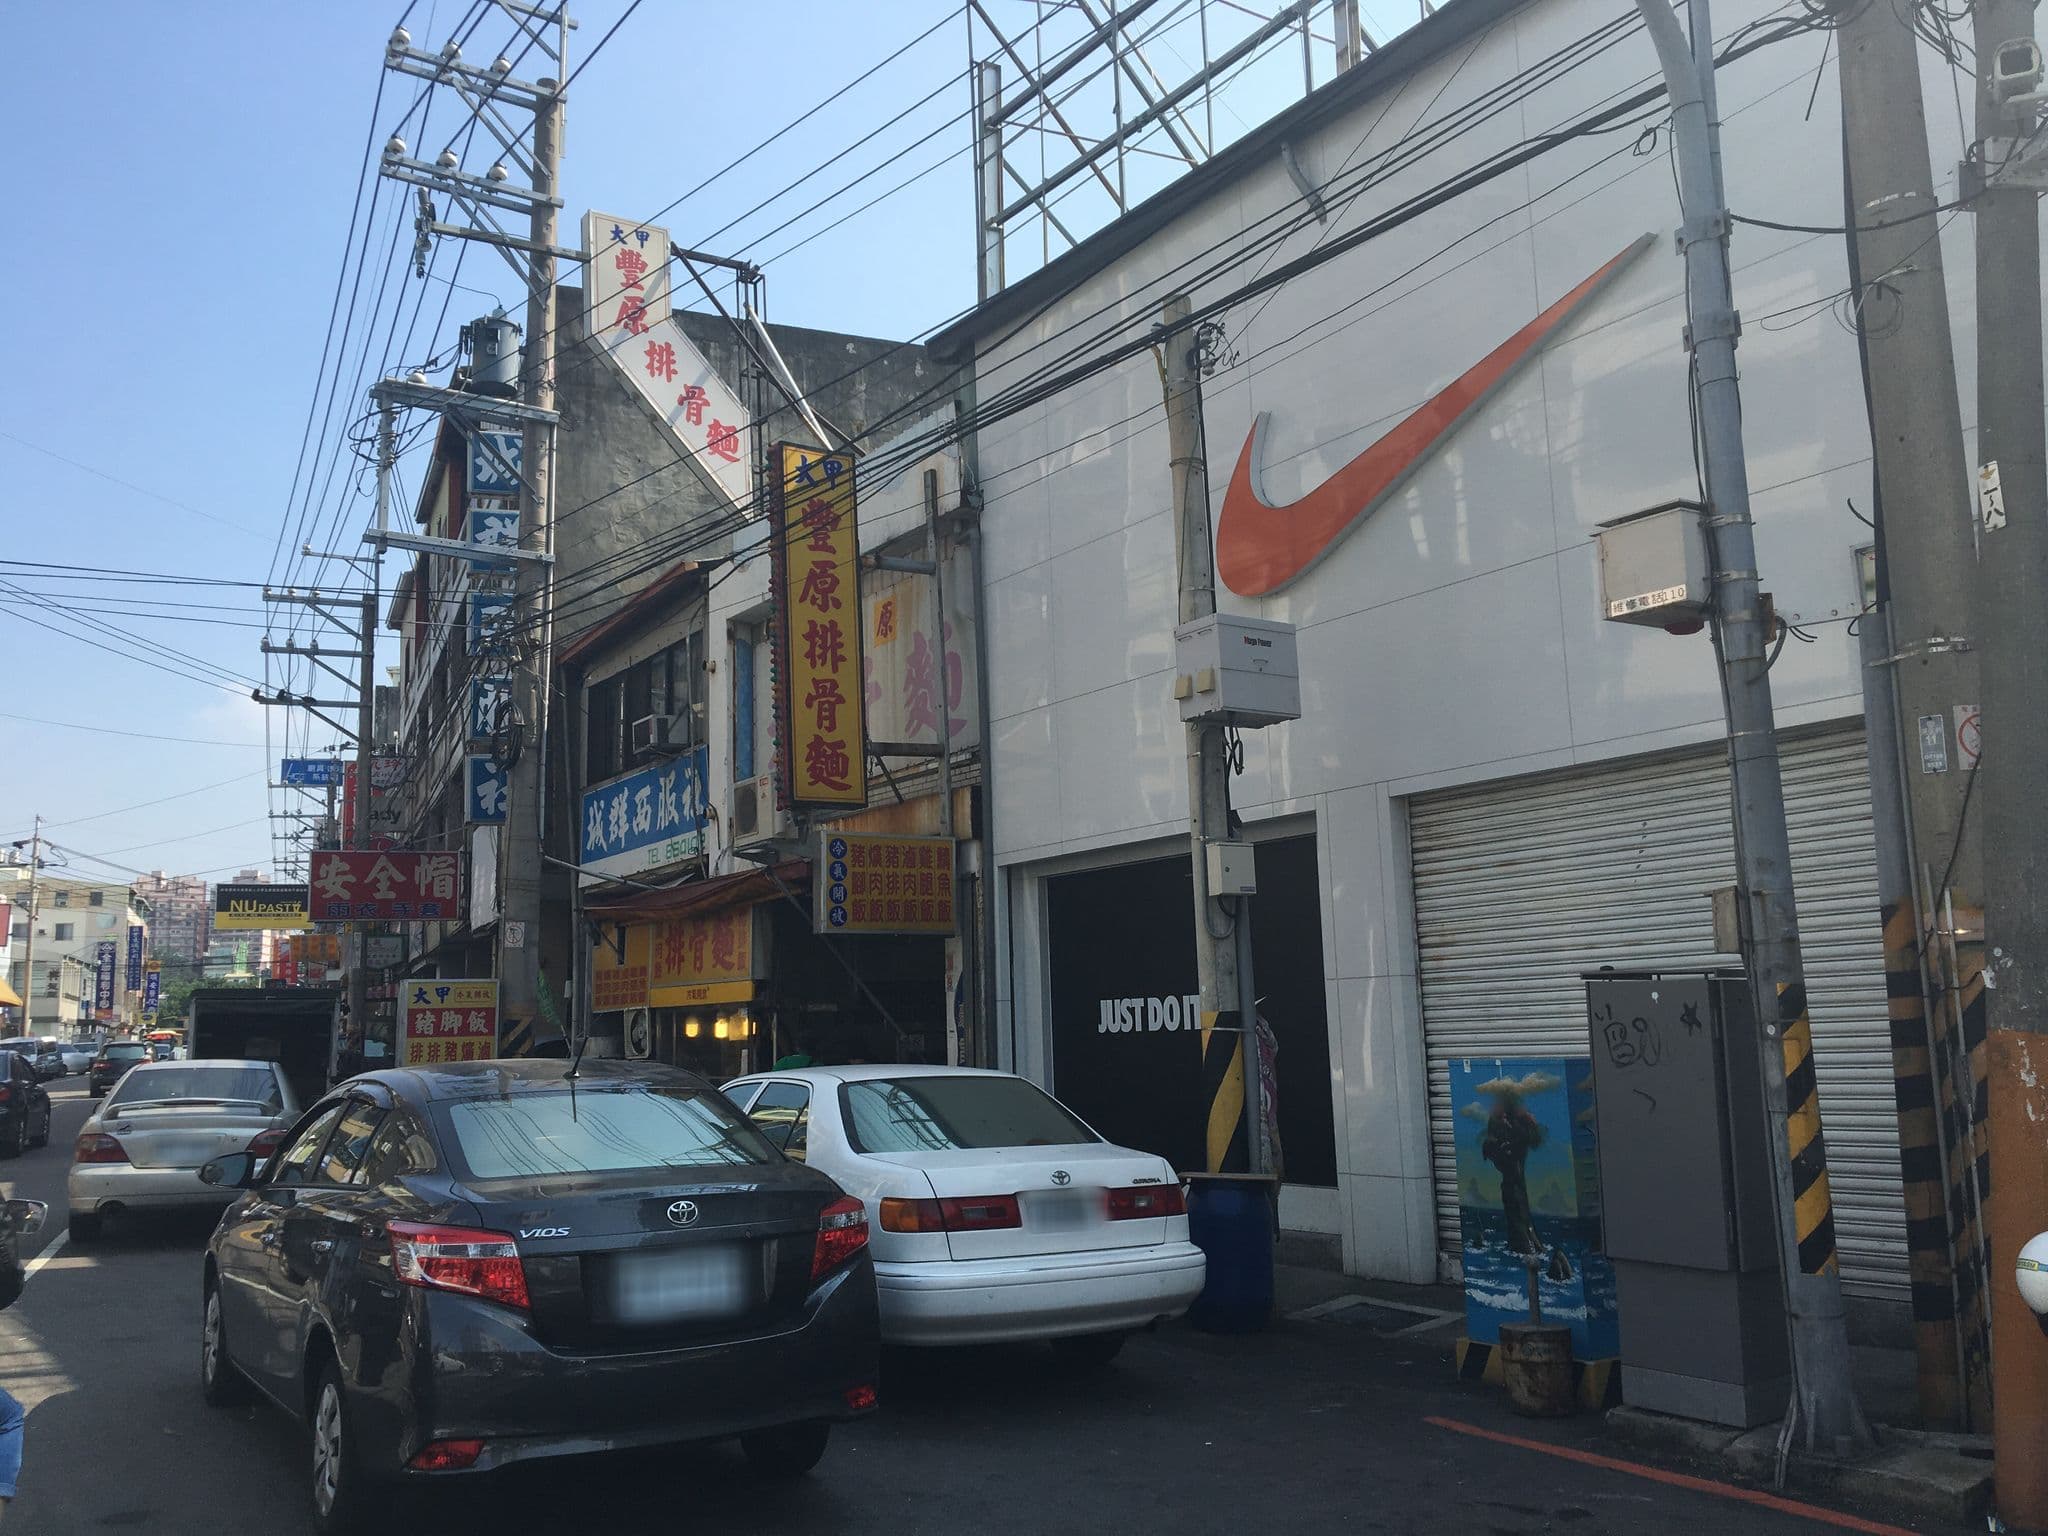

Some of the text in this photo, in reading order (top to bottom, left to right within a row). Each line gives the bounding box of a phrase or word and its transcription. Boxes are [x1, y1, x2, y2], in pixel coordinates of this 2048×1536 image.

[609, 223, 651, 249] 大甲
[794, 454, 844, 491] 大甲
[876, 600, 893, 638] 原
[797, 497, 853, 792] 豐原排骨麵
[586, 767, 705, 852] 城群西服社
[313, 854, 457, 901] 安全帽
[831, 840, 846, 924] 冷氣開放
[229, 899, 257, 913] NU
[412, 986, 451, 1005] 大甲
[1098, 994, 1201, 1034] JUST DO IT
[519, 1226, 572, 1239] VIOS
